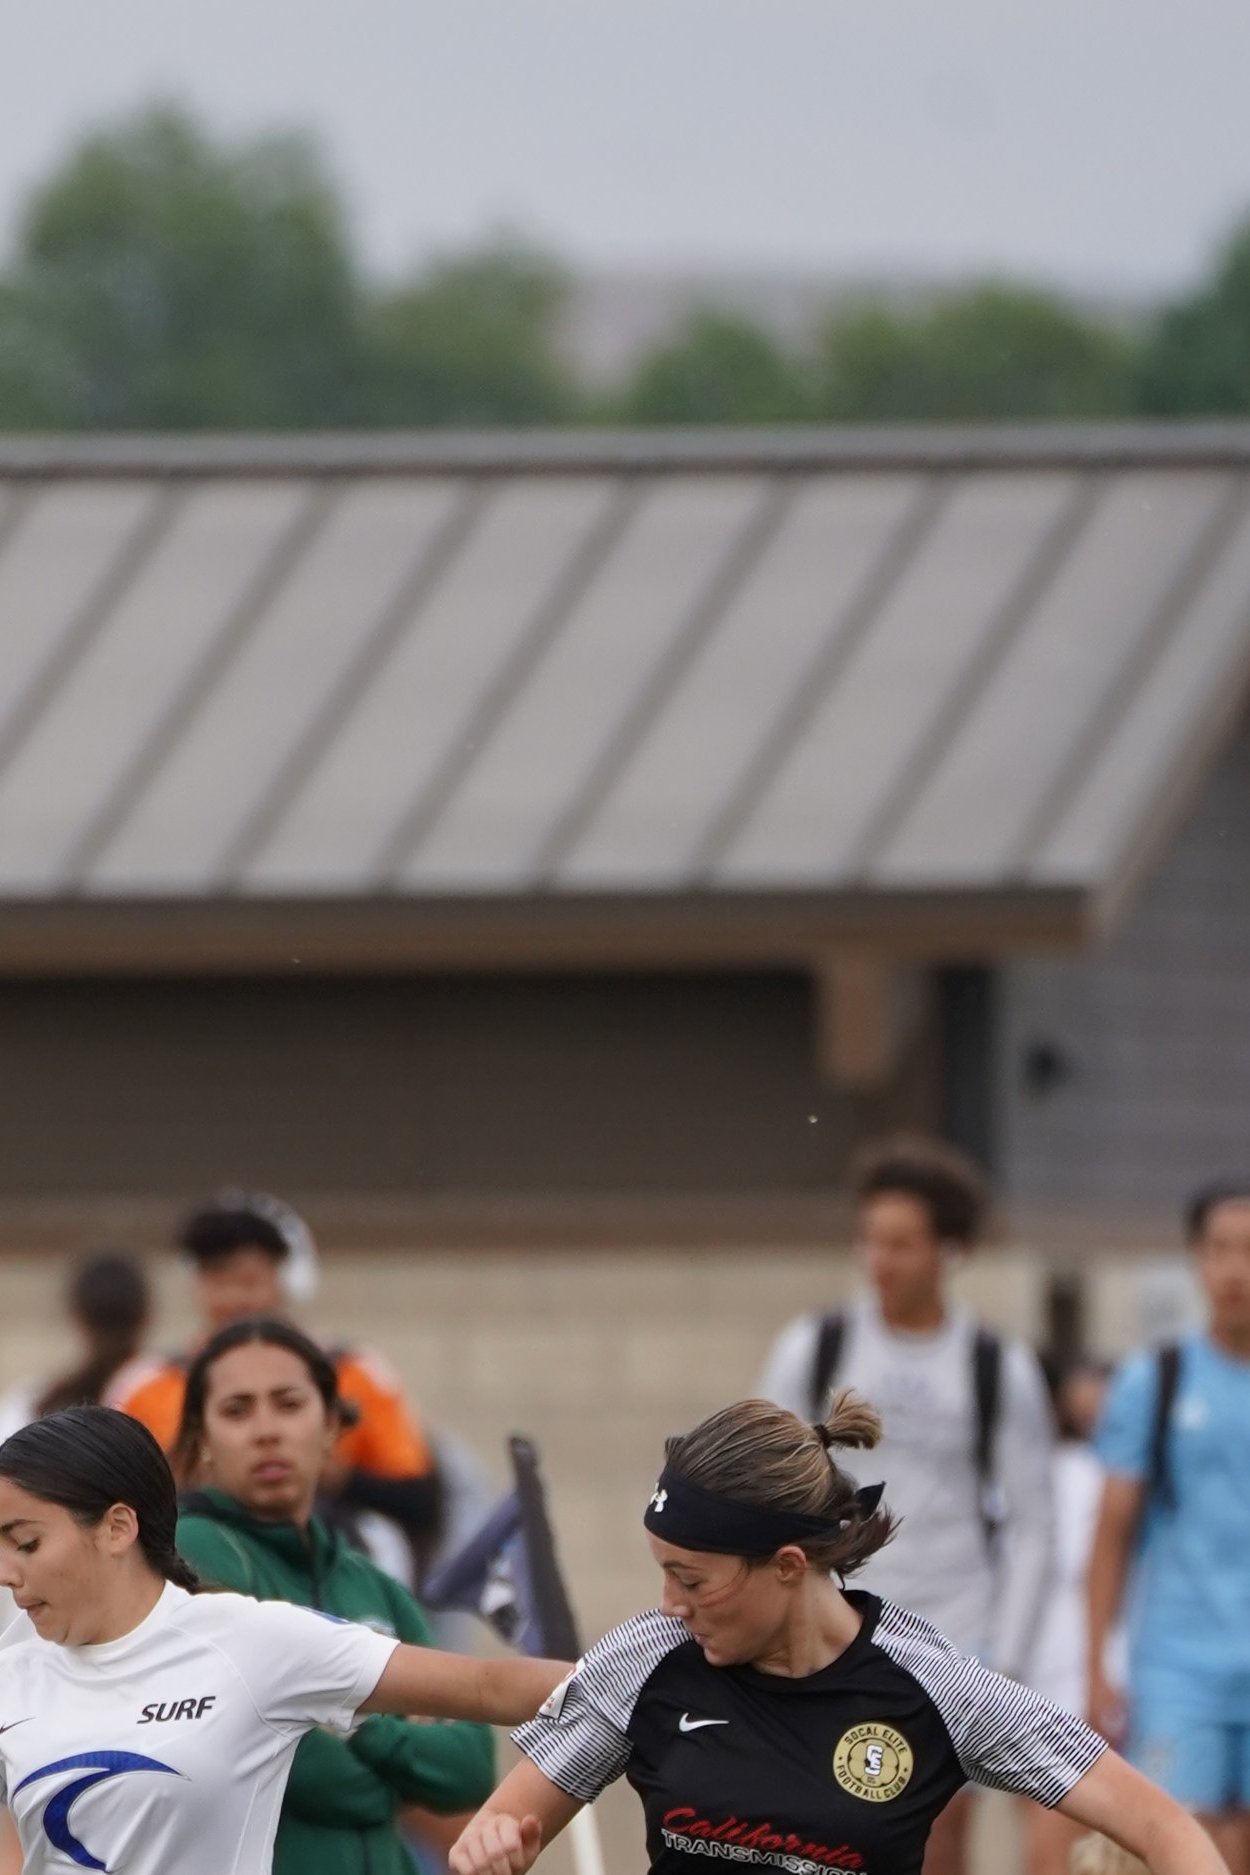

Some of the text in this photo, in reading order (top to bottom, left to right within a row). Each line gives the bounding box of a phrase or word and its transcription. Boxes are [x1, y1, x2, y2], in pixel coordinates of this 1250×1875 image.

[137, 1696, 216, 1724] SURF
[844, 1726, 908, 1754] SOCAL ELITE
[836, 1764, 906, 1799] FOOTBALL CLUB
[663, 1807, 863, 1869] California
